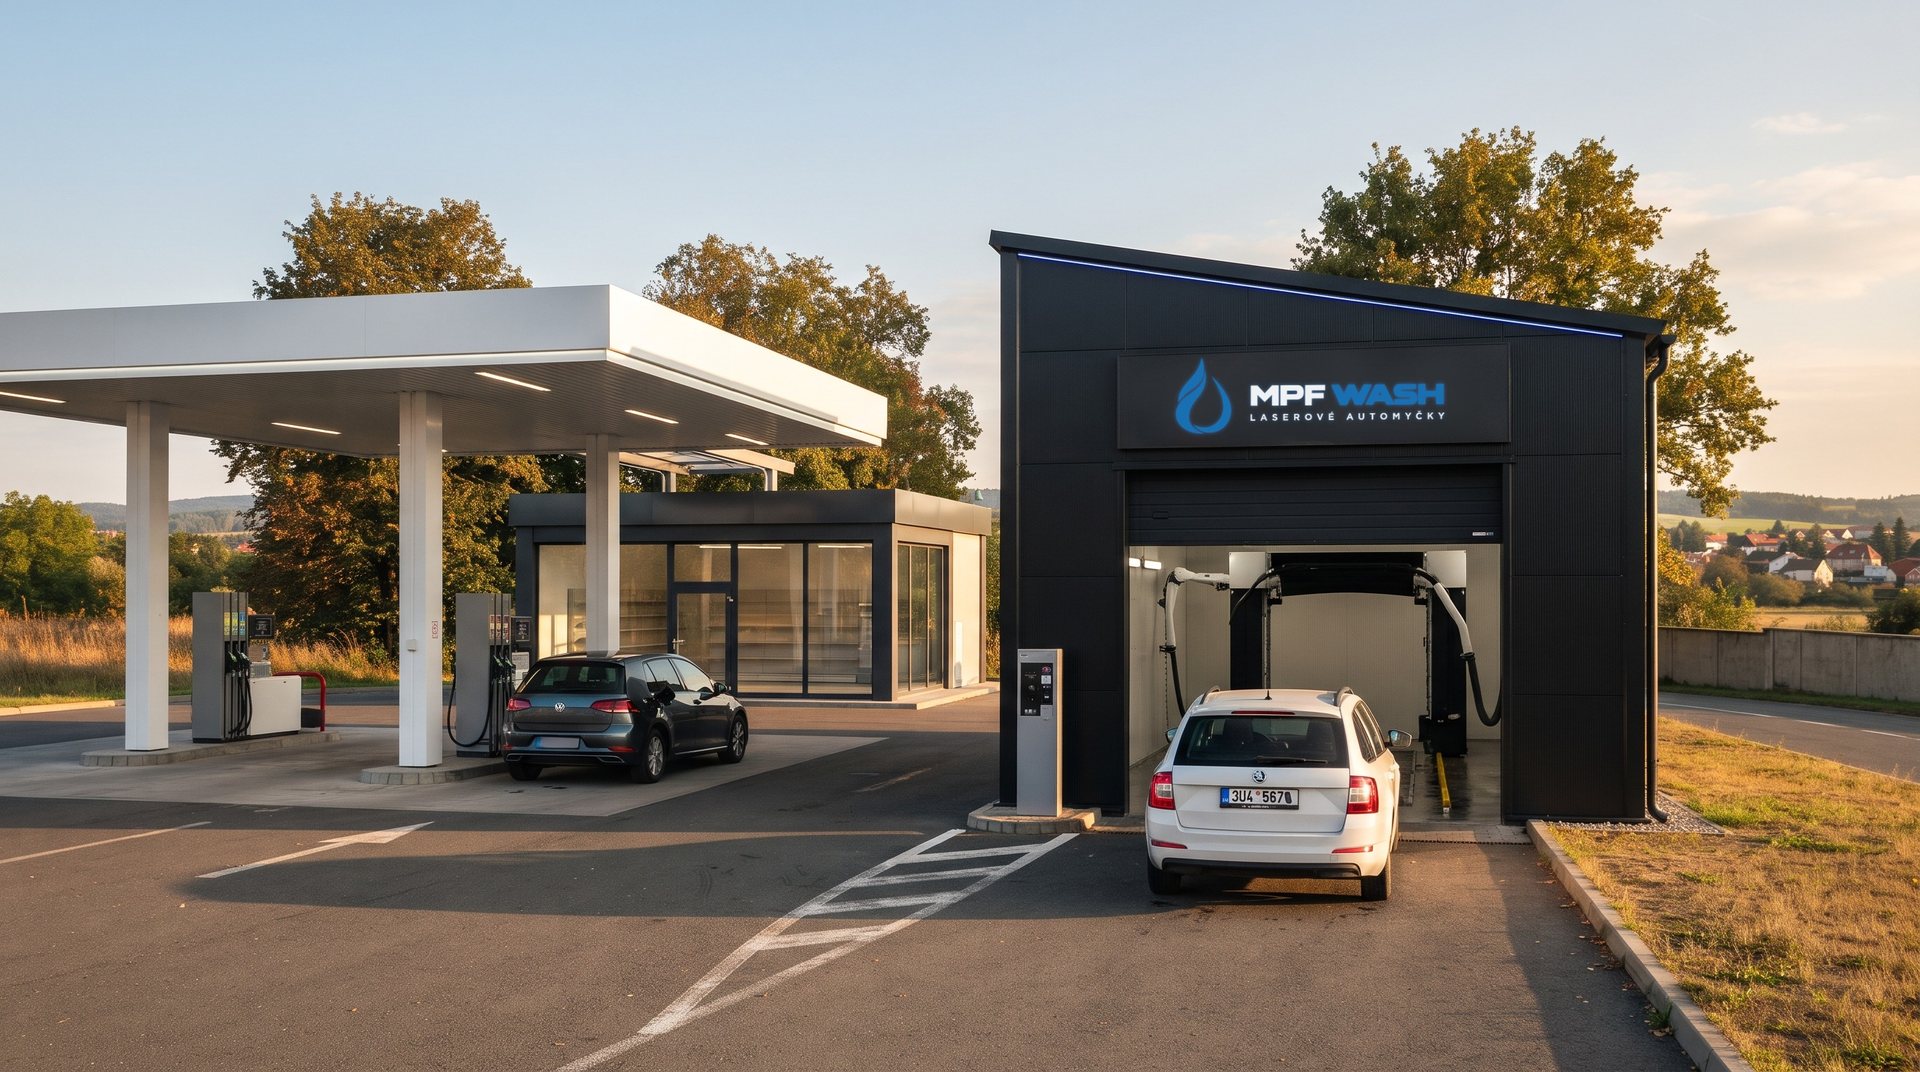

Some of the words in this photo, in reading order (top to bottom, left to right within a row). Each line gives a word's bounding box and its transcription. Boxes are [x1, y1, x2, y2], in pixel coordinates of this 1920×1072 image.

[1250, 384, 1326, 407] MPF
[1331, 383, 1445, 406] WASH
[1249, 411, 1335, 422] LASEROVÉ
[1346, 410, 1446, 421] AUTOMYČKY
[1232, 790, 1253, 802] 3U4
[1262, 791, 1292, 804] 567
